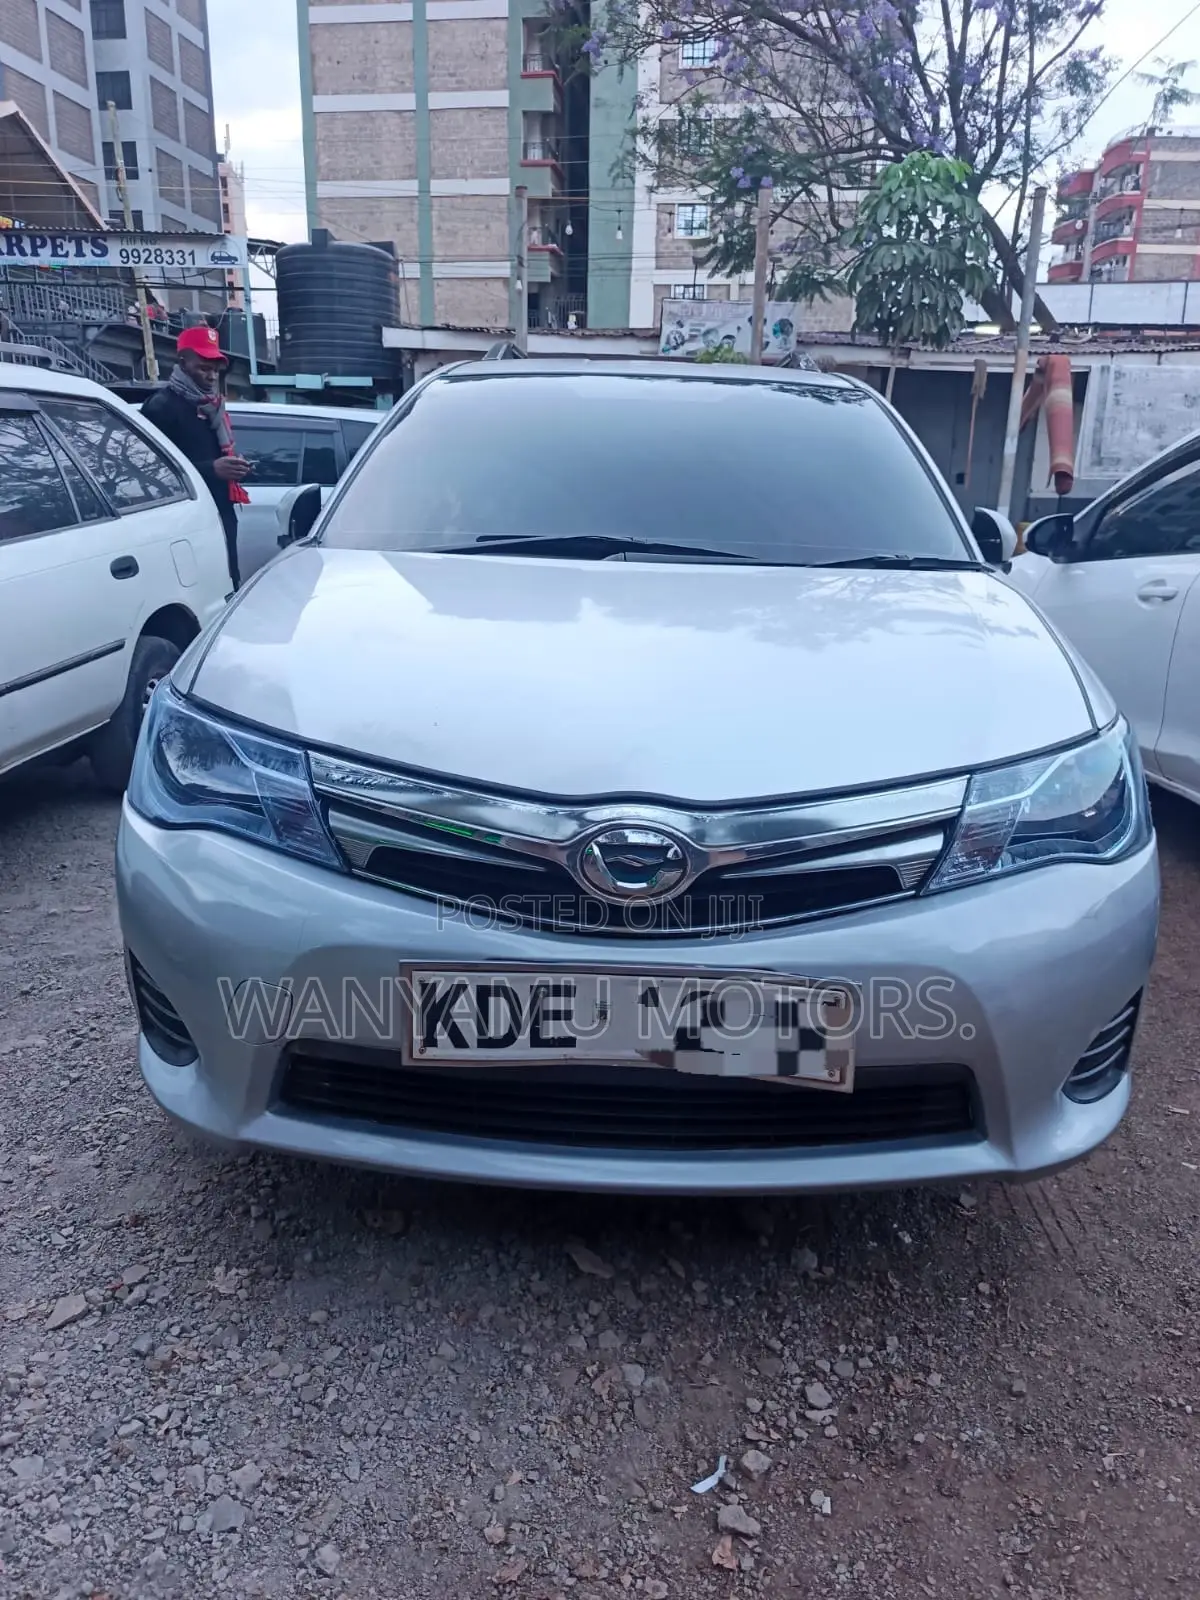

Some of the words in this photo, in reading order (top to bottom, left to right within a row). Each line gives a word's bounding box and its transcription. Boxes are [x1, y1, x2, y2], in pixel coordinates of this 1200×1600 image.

[0, 233, 109, 258] RPETS
[119, 247, 196, 266] 9928331
[420, 983, 577, 1049] KDE
